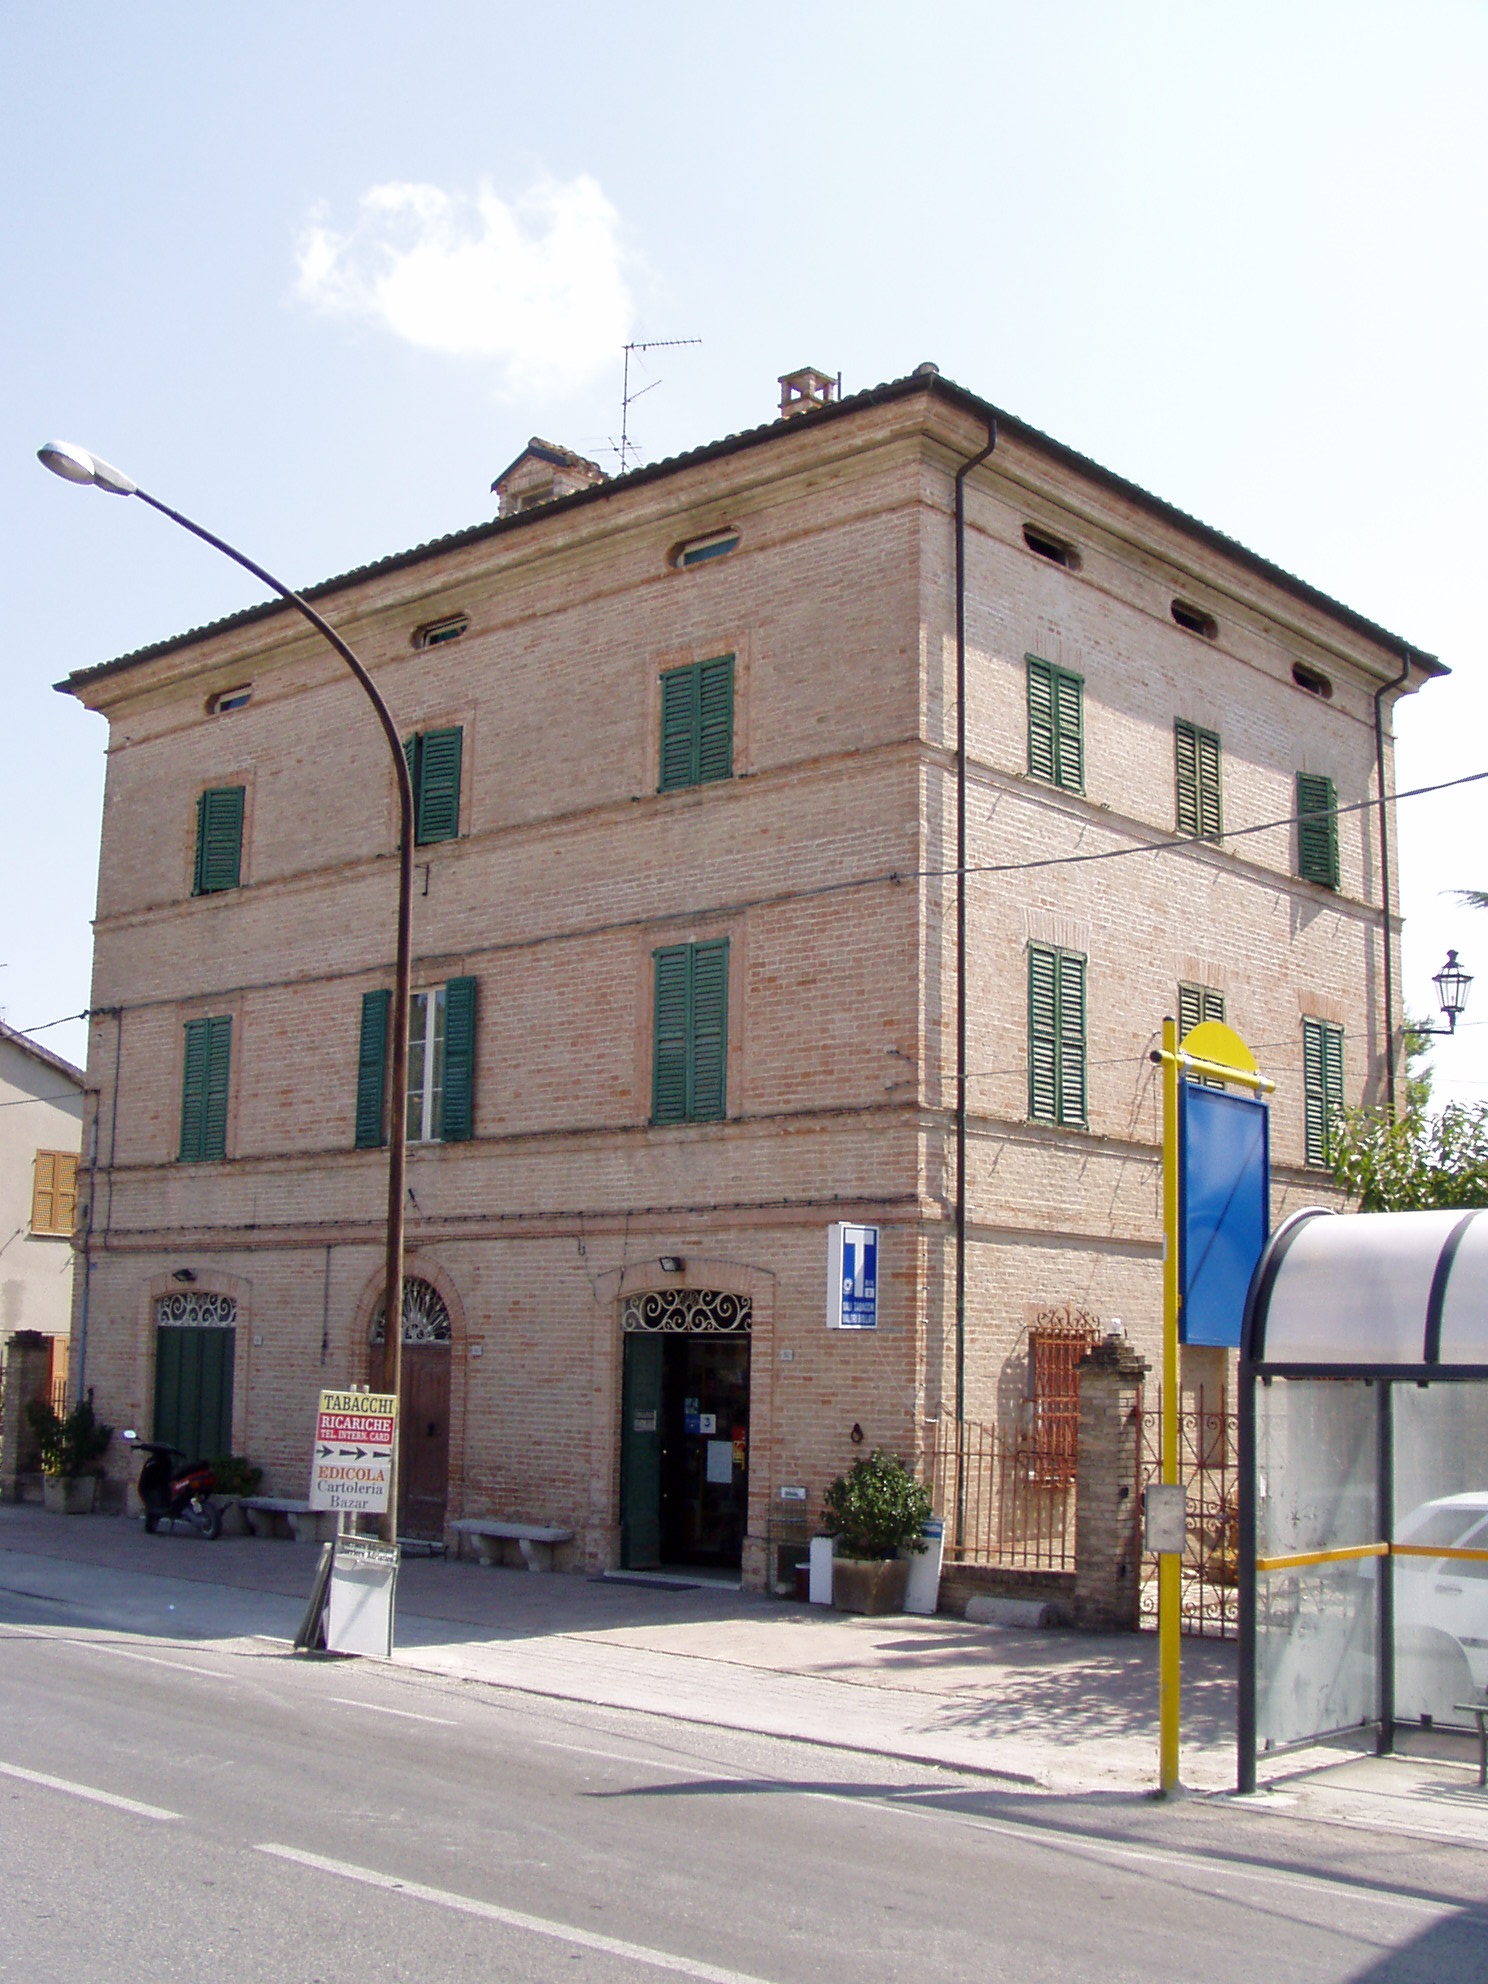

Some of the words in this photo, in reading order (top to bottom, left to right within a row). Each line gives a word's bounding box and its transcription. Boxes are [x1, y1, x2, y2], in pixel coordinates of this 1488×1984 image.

[845, 1229, 875, 1298] T
[324, 1395, 394, 1414] TABACCHI
[321, 1416, 392, 1432] RICARICHE
[321, 1430, 337, 1439] TEL.
[369, 1433, 390, 1442] CARD
[318, 1466, 385, 1482] EDICOLA
[317, 1480, 383, 1495] Cartoleria
[330, 1496, 368, 1509] Bazar
